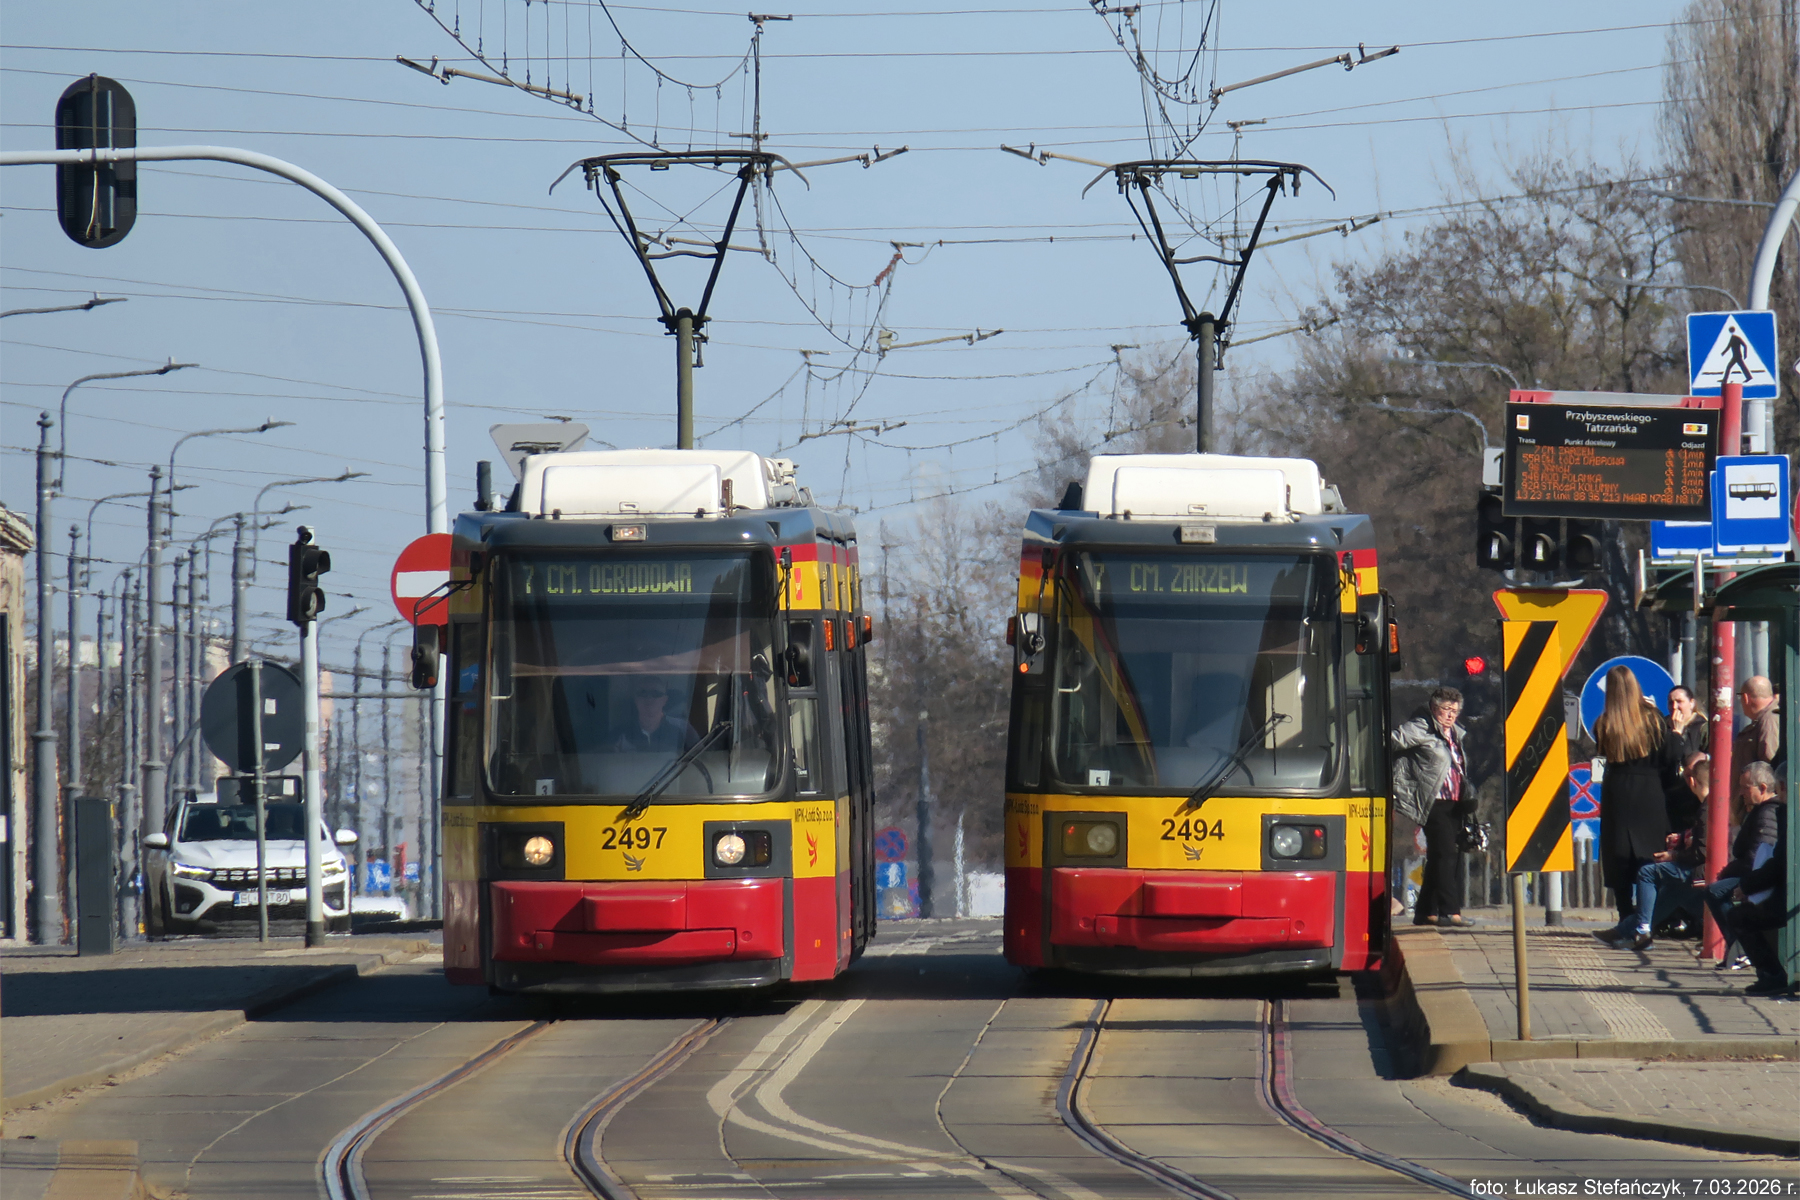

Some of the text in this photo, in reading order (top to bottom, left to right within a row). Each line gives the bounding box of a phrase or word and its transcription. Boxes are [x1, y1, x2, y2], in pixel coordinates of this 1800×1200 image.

[1565, 410, 1652, 424] Przybyszewskiego
[1585, 422, 1638, 434] Tatrzańska
[1518, 436, 1536, 444] Trasa
[1564, 438, 1584, 447] Punkt
[1681, 441, 1705, 450] Odjazd
[523, 563, 692, 594] 7 CM. OGRODOWA
[1093, 562, 1248, 593] 7 CM. ZARZEW
[1160, 818, 1225, 841] 2494
[601, 827, 667, 850] 2497
